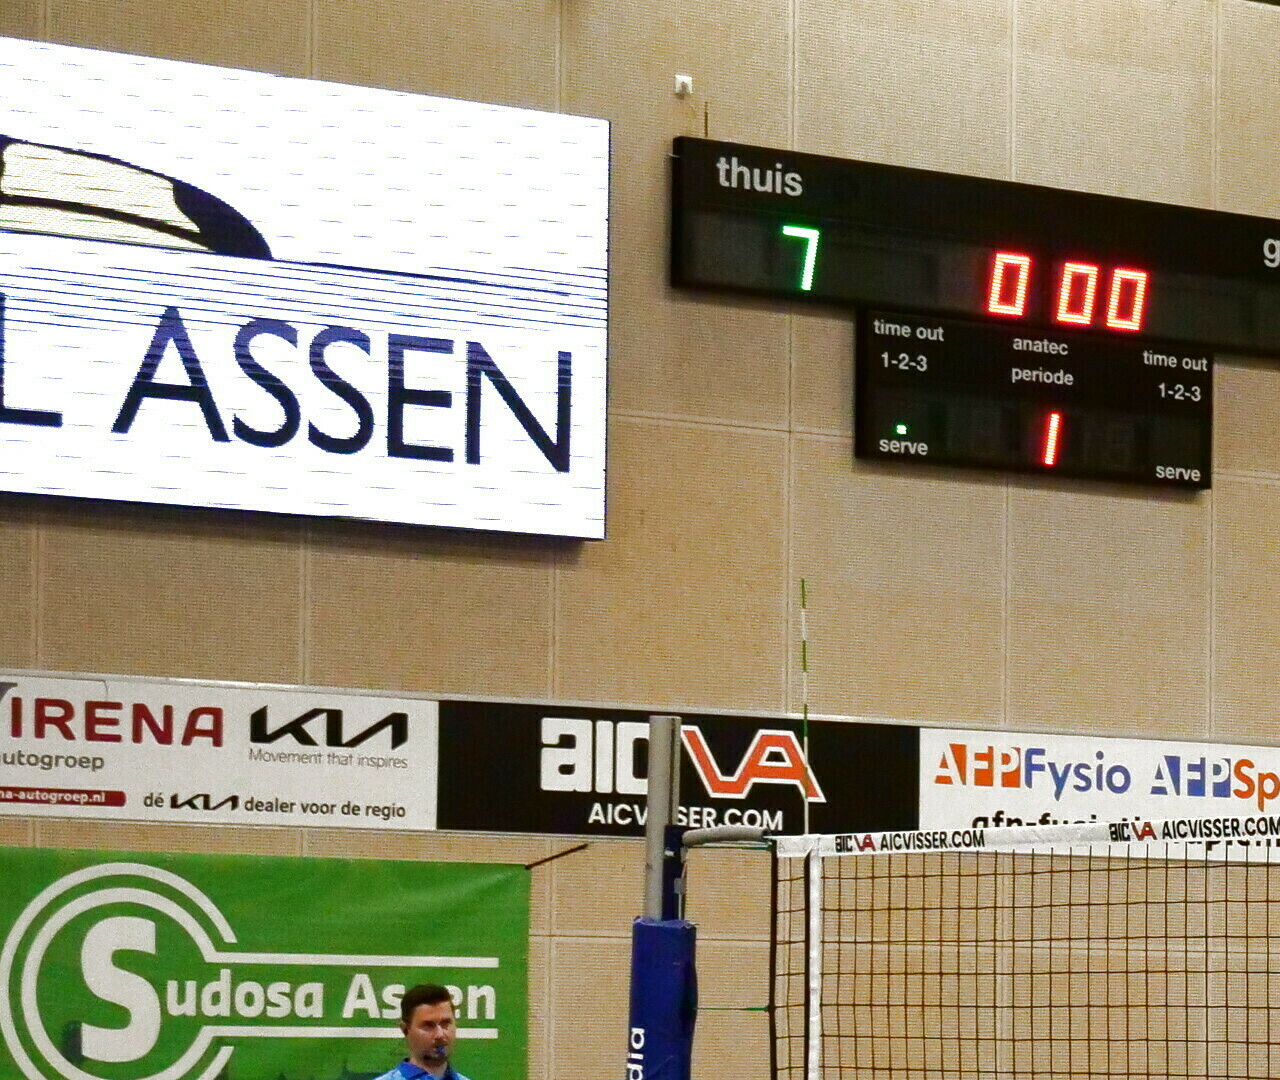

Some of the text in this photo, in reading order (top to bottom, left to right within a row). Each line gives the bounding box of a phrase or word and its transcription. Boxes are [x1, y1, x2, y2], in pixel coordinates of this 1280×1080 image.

[716, 156, 803, 197] thuis
[783, 224, 819, 291] 7
[873, 319, 944, 342] time out
[1012, 335, 1069, 357] anatec
[880, 351, 928, 373] 1-2-3
[1142, 350, 1208, 373] time out
[1011, 364, 1074, 388] periode
[111, 306, 572, 473] ASSEN
[1157, 381, 1202, 403] 1-2-3
[878, 437, 928, 457] serve
[1043, 412, 1061, 466] 1
[1155, 463, 1201, 483] serve
[0, 750, 105, 772] utogroep
[249, 748, 409, 770] Movement that inspires
[143, 792, 165, 808] dé
[244, 797, 297, 814] dealer
[300, 802, 337, 815] voor
[341, 801, 361, 816] de
[365, 802, 407, 821] regio
[588, 801, 784, 832] AICVSSER.COM
[880, 830, 986, 852] AICVISSER.COM
[81, 915, 497, 1063] Sudosa Asen
